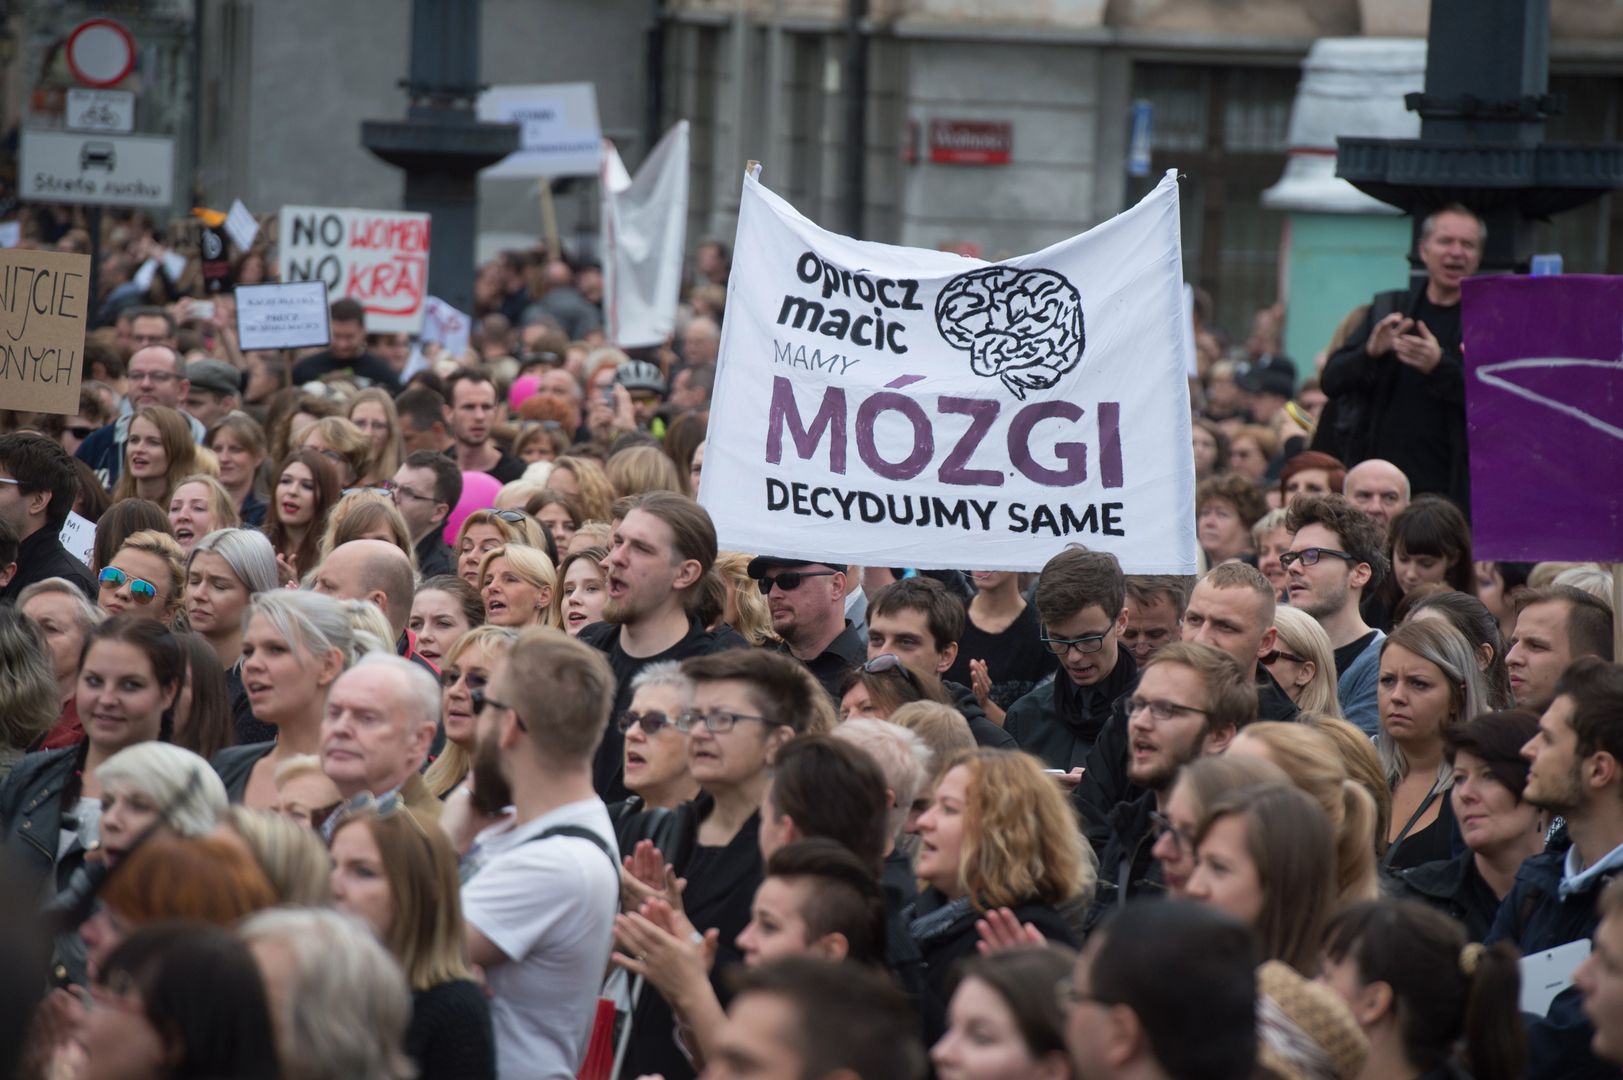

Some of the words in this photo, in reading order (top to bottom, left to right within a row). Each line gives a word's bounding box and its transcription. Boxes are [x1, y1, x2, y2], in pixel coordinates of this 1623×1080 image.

[291, 213, 344, 248] NO
[350, 217, 431, 253] WOMEN
[289, 254, 342, 292] NO
[776, 294, 909, 354] macic
[773, 338, 861, 375] MAMY
[765, 374, 1124, 488] MÓZGI
[765, 478, 998, 531] DECYDUJMY
[1007, 502, 1125, 537] SAME
